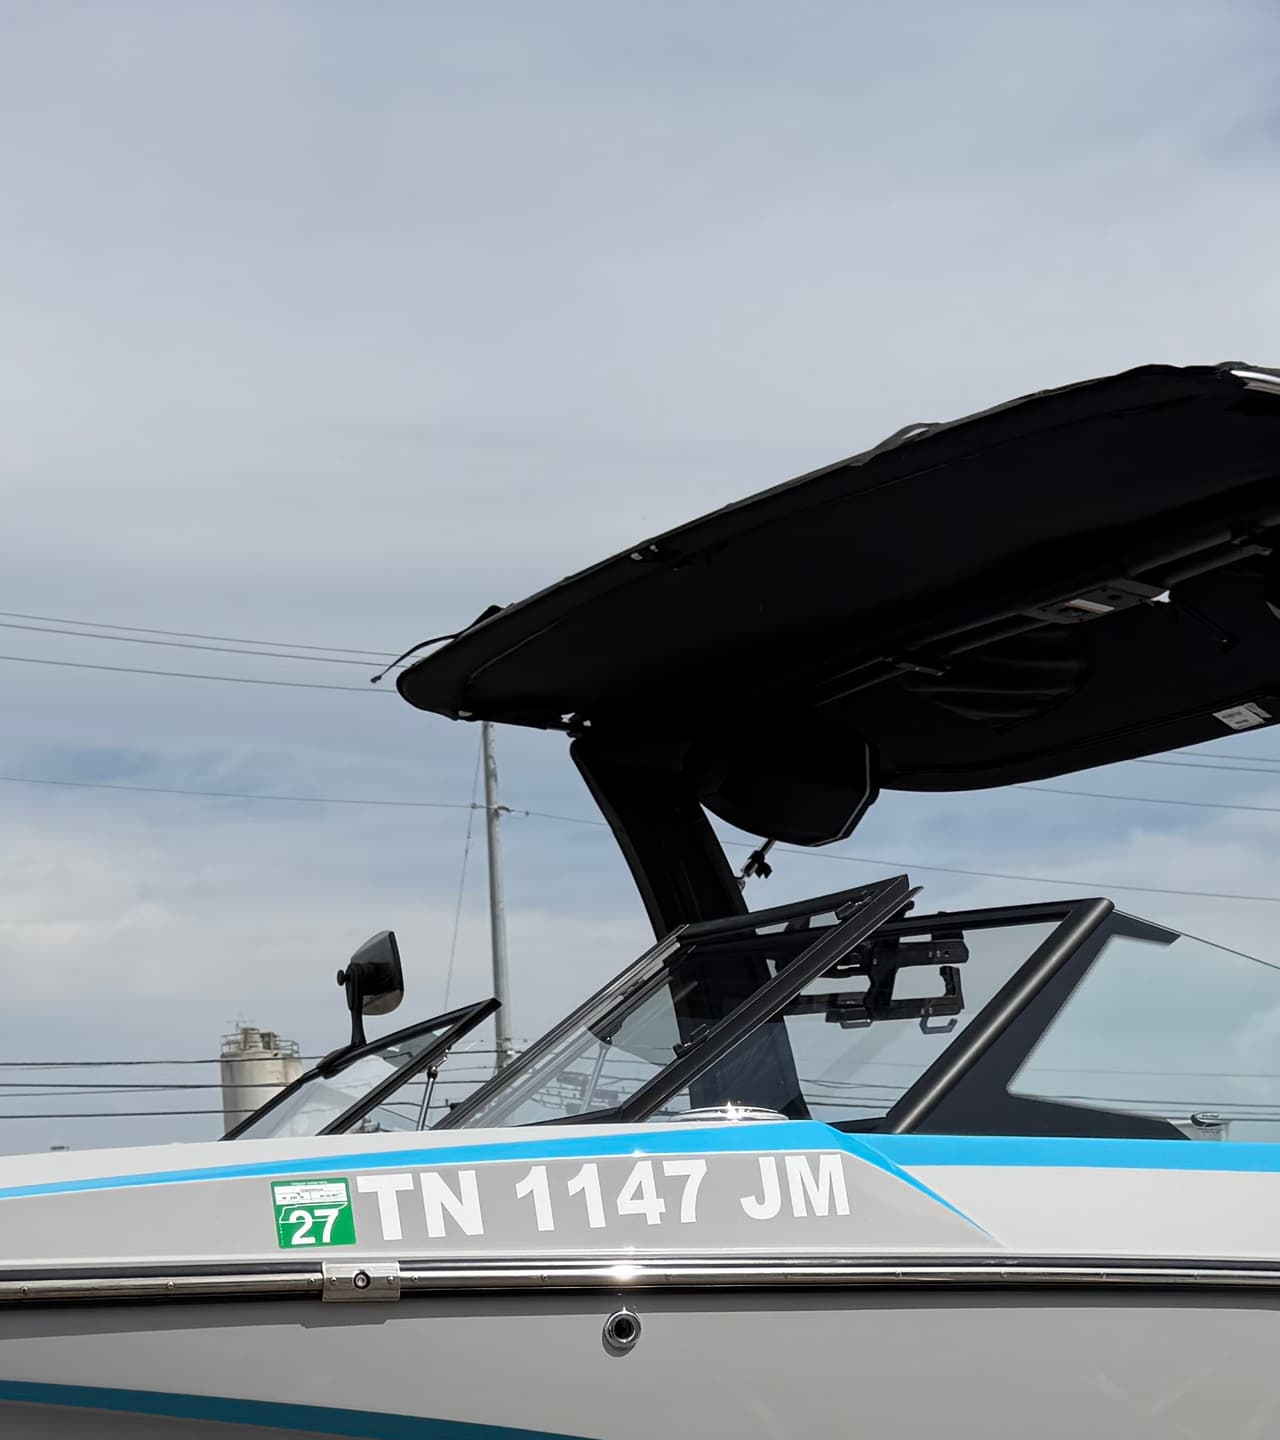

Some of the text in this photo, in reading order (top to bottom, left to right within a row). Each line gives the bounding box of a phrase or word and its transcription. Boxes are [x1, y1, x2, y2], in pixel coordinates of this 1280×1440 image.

[289, 1208, 339, 1245] 27
[356, 1154, 851, 1241] TN 1147 JM
